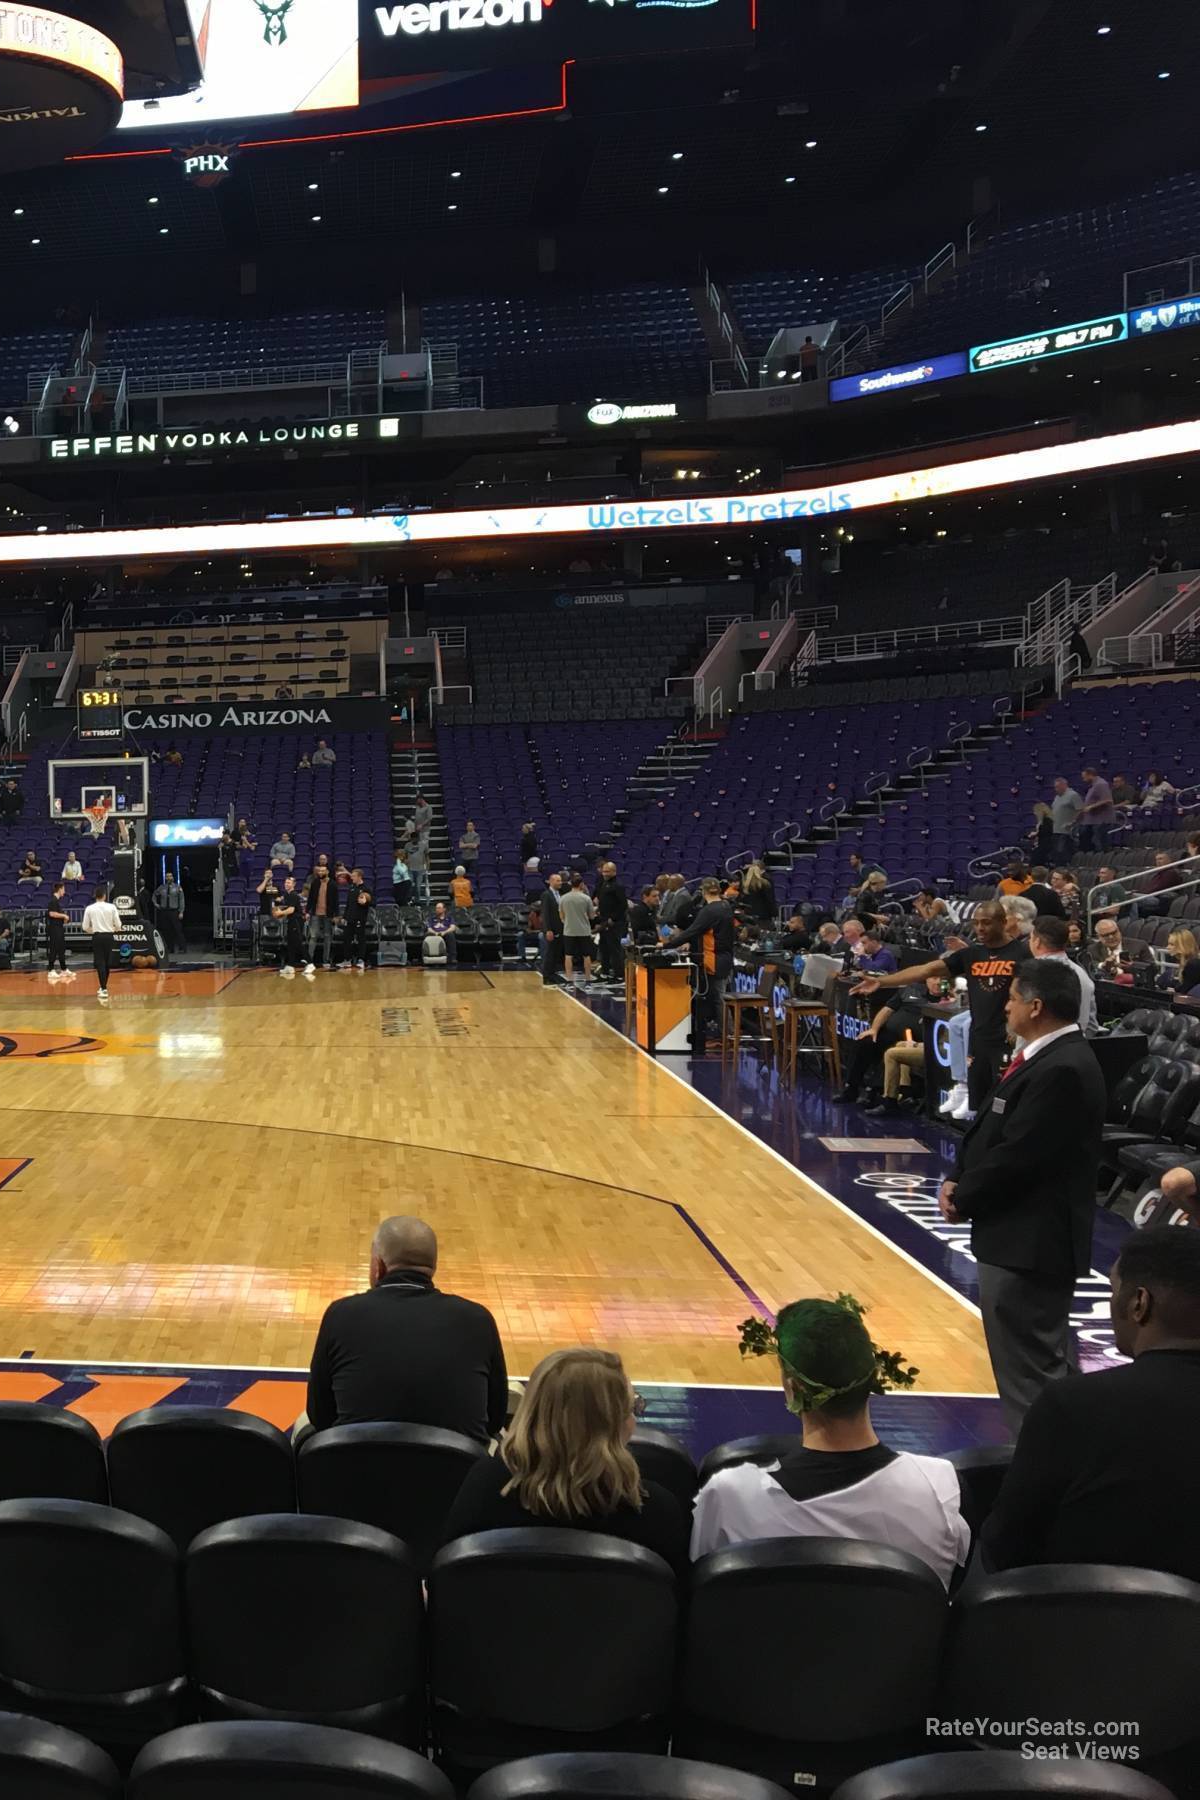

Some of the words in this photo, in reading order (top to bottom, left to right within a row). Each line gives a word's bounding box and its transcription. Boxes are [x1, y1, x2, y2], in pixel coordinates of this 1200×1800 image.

[375, 0, 542, 36] verizon
[184, 154, 230, 173] PHX
[859, 366, 926, 392] Southwest
[51, 434, 157, 459] EFFEN
[166, 431, 249, 448] VODKA
[258, 423, 359, 442] LOUNGE
[587, 500, 714, 529] Wetzel's
[727, 490, 851, 524] Pretzels
[574, 593, 625, 605] annexus
[83, 691, 118, 707] 67:31
[123, 709, 213, 731] CASINO
[219, 706, 332, 728] ARIZONA
[92, 729, 121, 738] TISSOT
[121, 924, 145, 932] SINO
[113, 934, 148, 942] RIZONA
[971, 960, 1016, 977] SUNS
